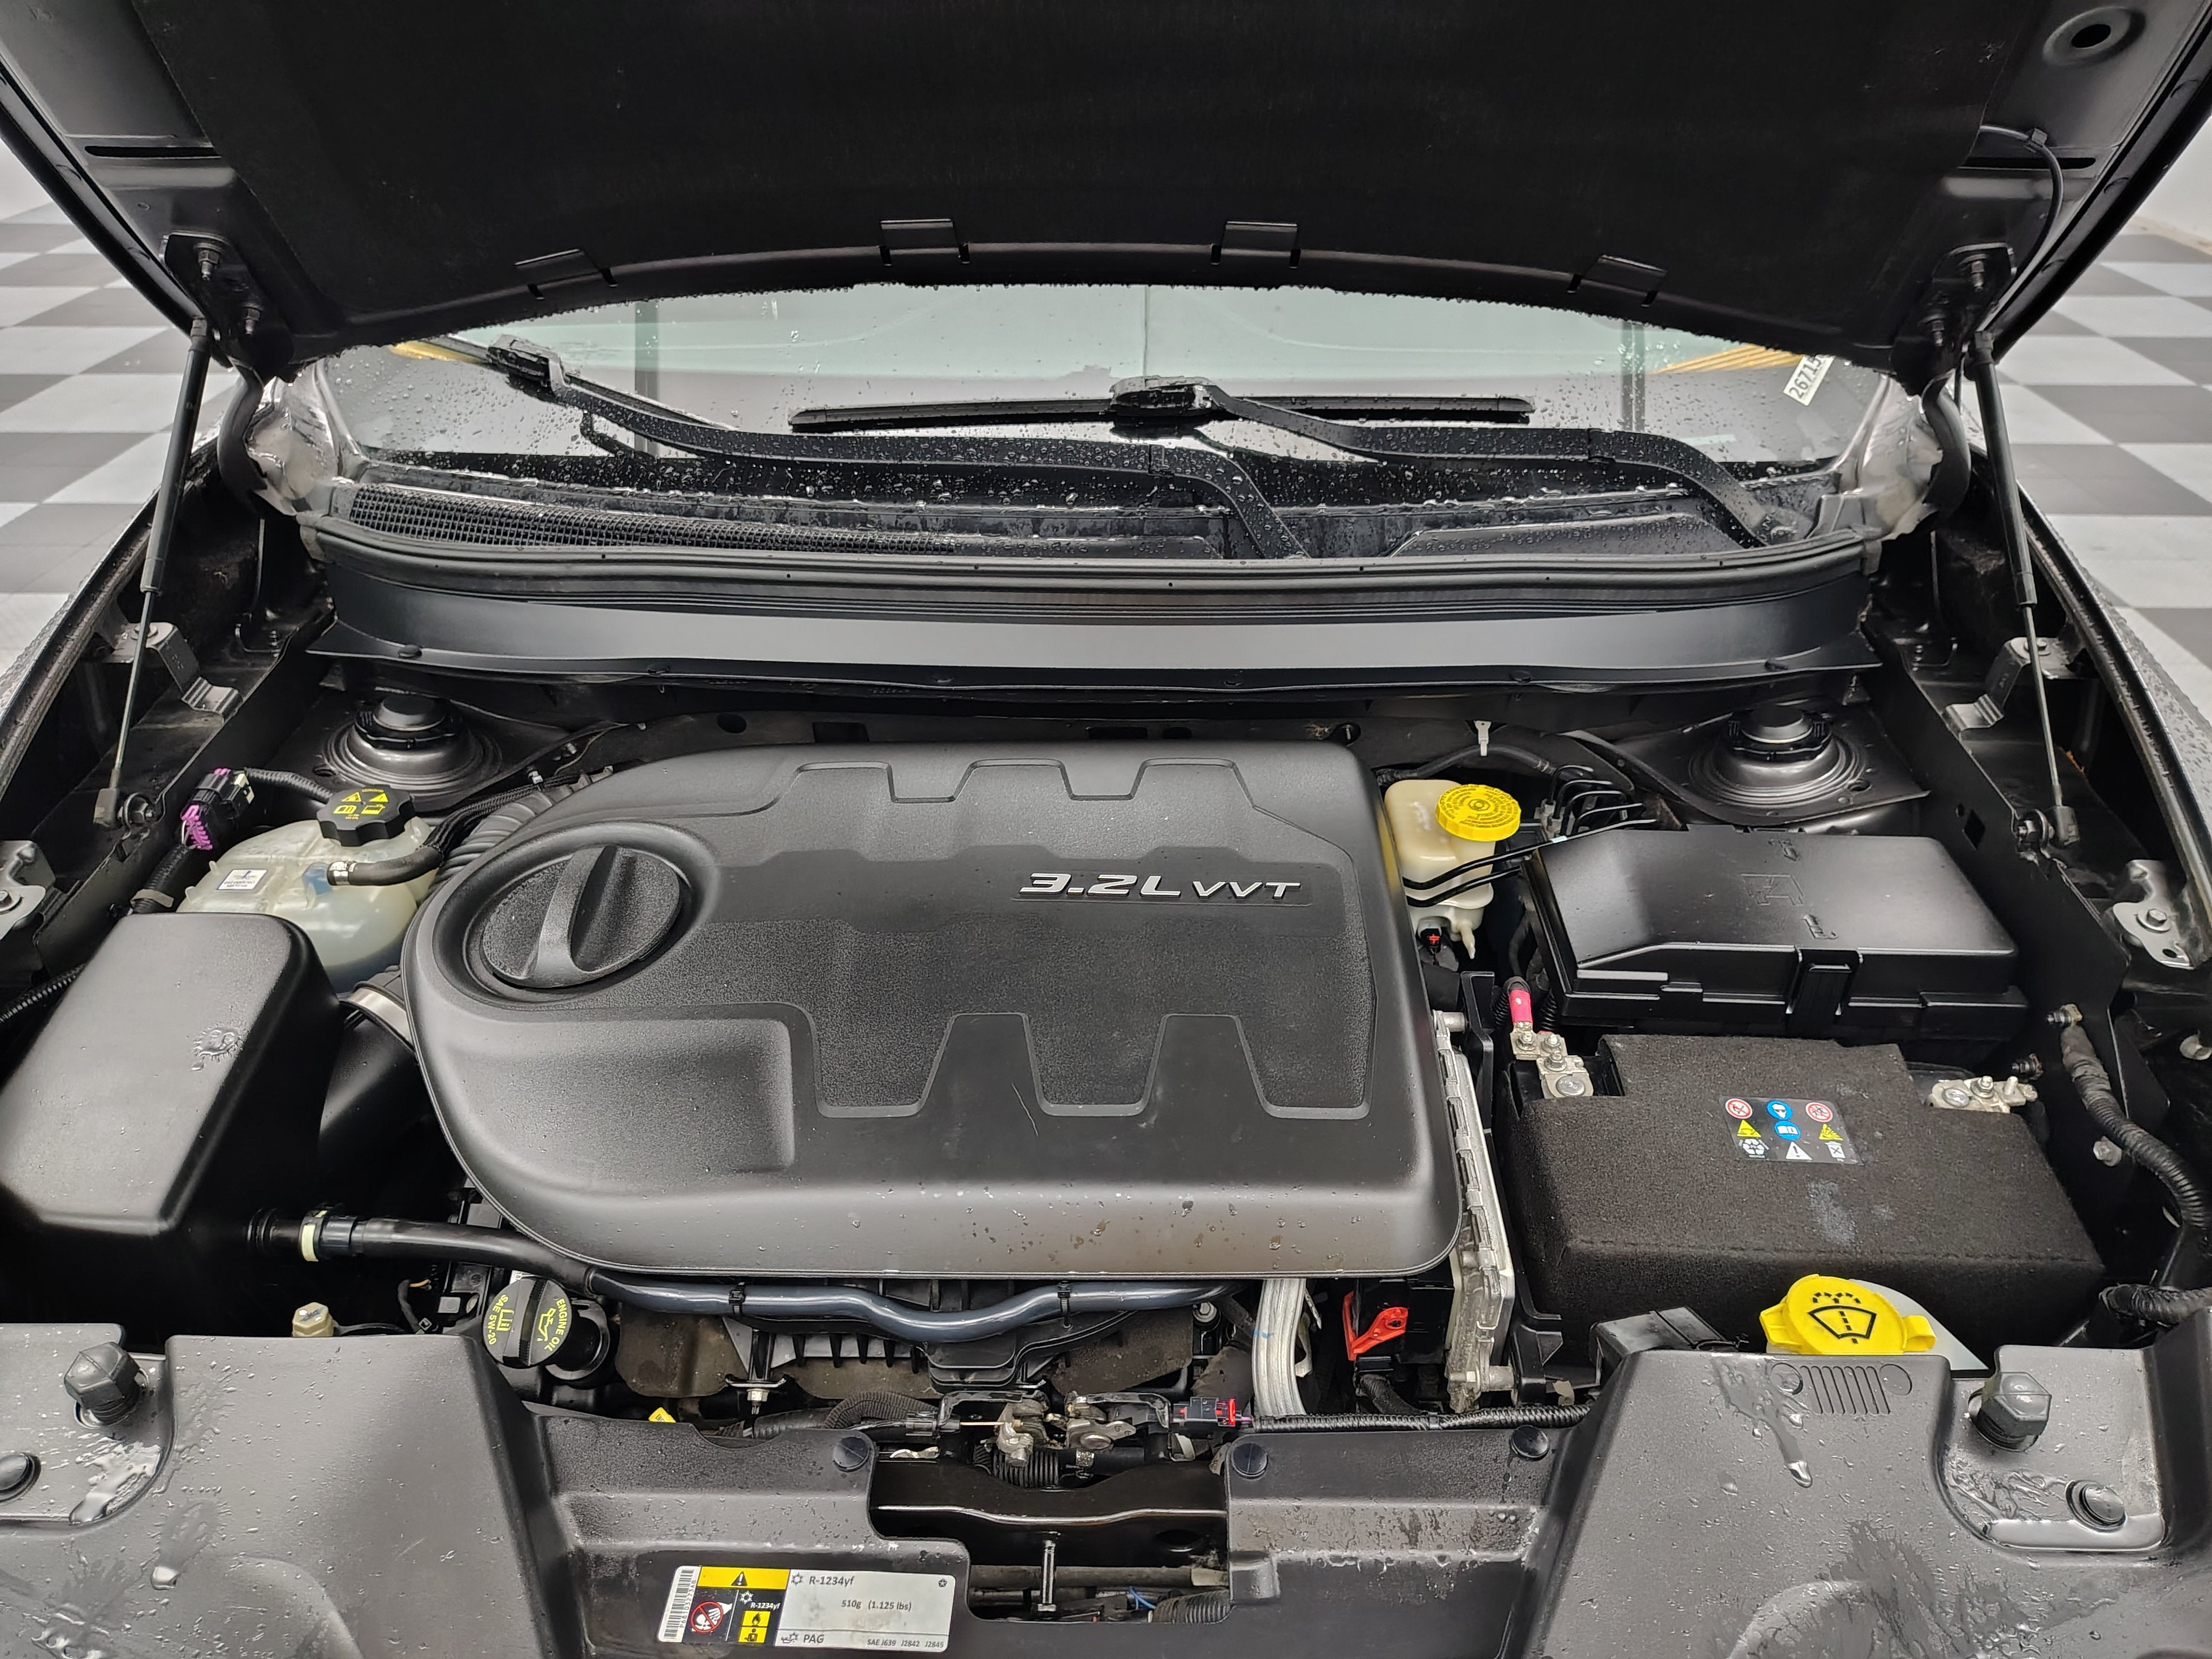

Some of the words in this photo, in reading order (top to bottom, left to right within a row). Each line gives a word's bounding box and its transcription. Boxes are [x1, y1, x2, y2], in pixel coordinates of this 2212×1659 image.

[1019, 872, 1181, 898] 3.2L
[1191, 881, 1301, 900] VVT
[493, 1294, 508, 1313] SAE
[556, 1298, 567, 1335] ENGINE
[487, 1314, 497, 1345] 5W-20
[544, 1337, 559, 1351] OIL
[809, 1576, 855, 1588] R-1234yf
[750, 1602, 781, 1611] R-1234yf
[841, 1600, 861, 1610] 510g
[868, 1600, 894, 1610] (1.125
[896, 1601, 912, 1612] lbs)
[803, 1634, 825, 1643] PAG
[900, 1640, 920, 1648] J2842
